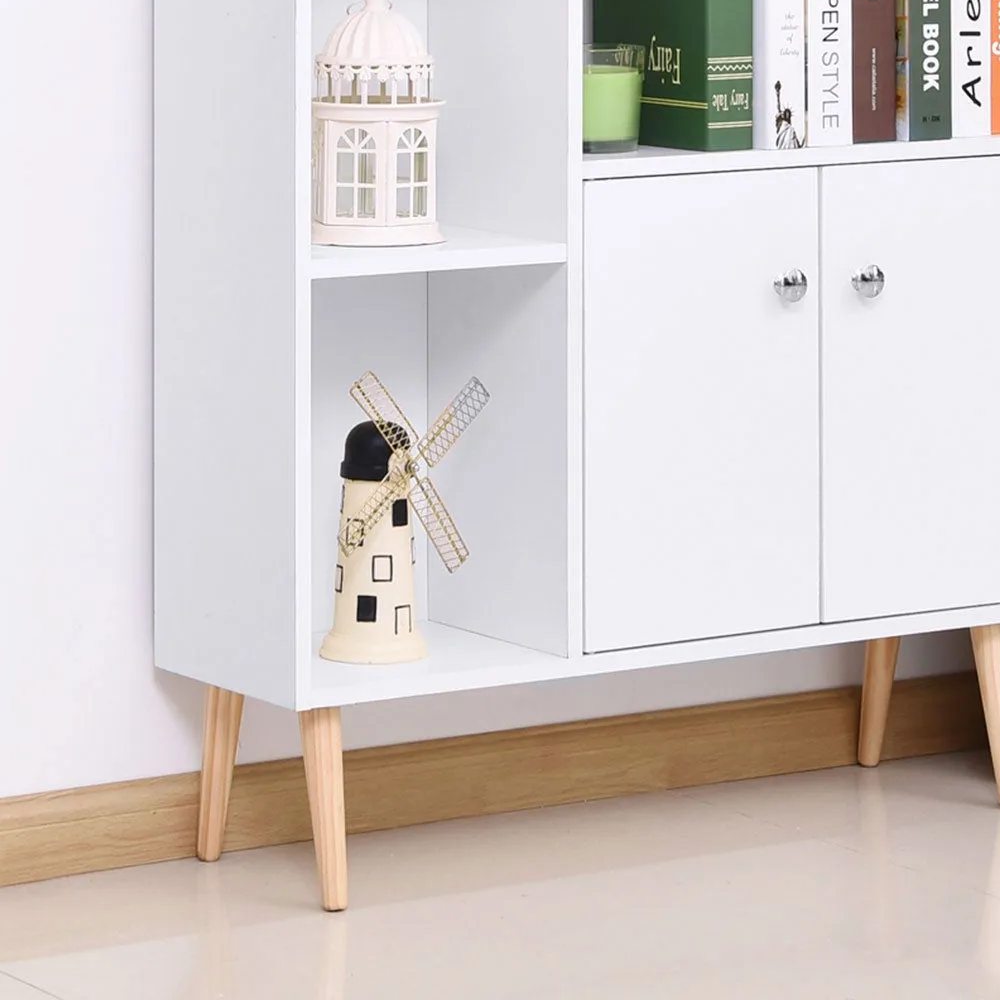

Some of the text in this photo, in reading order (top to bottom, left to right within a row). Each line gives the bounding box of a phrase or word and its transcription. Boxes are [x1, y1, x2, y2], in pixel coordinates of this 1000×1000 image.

[648, 35, 682, 84] Fairy
[922, 24, 940, 92] BOOK
[712, 92, 749, 111] Fairy Tale
[821, 53, 839, 129] STYLE
